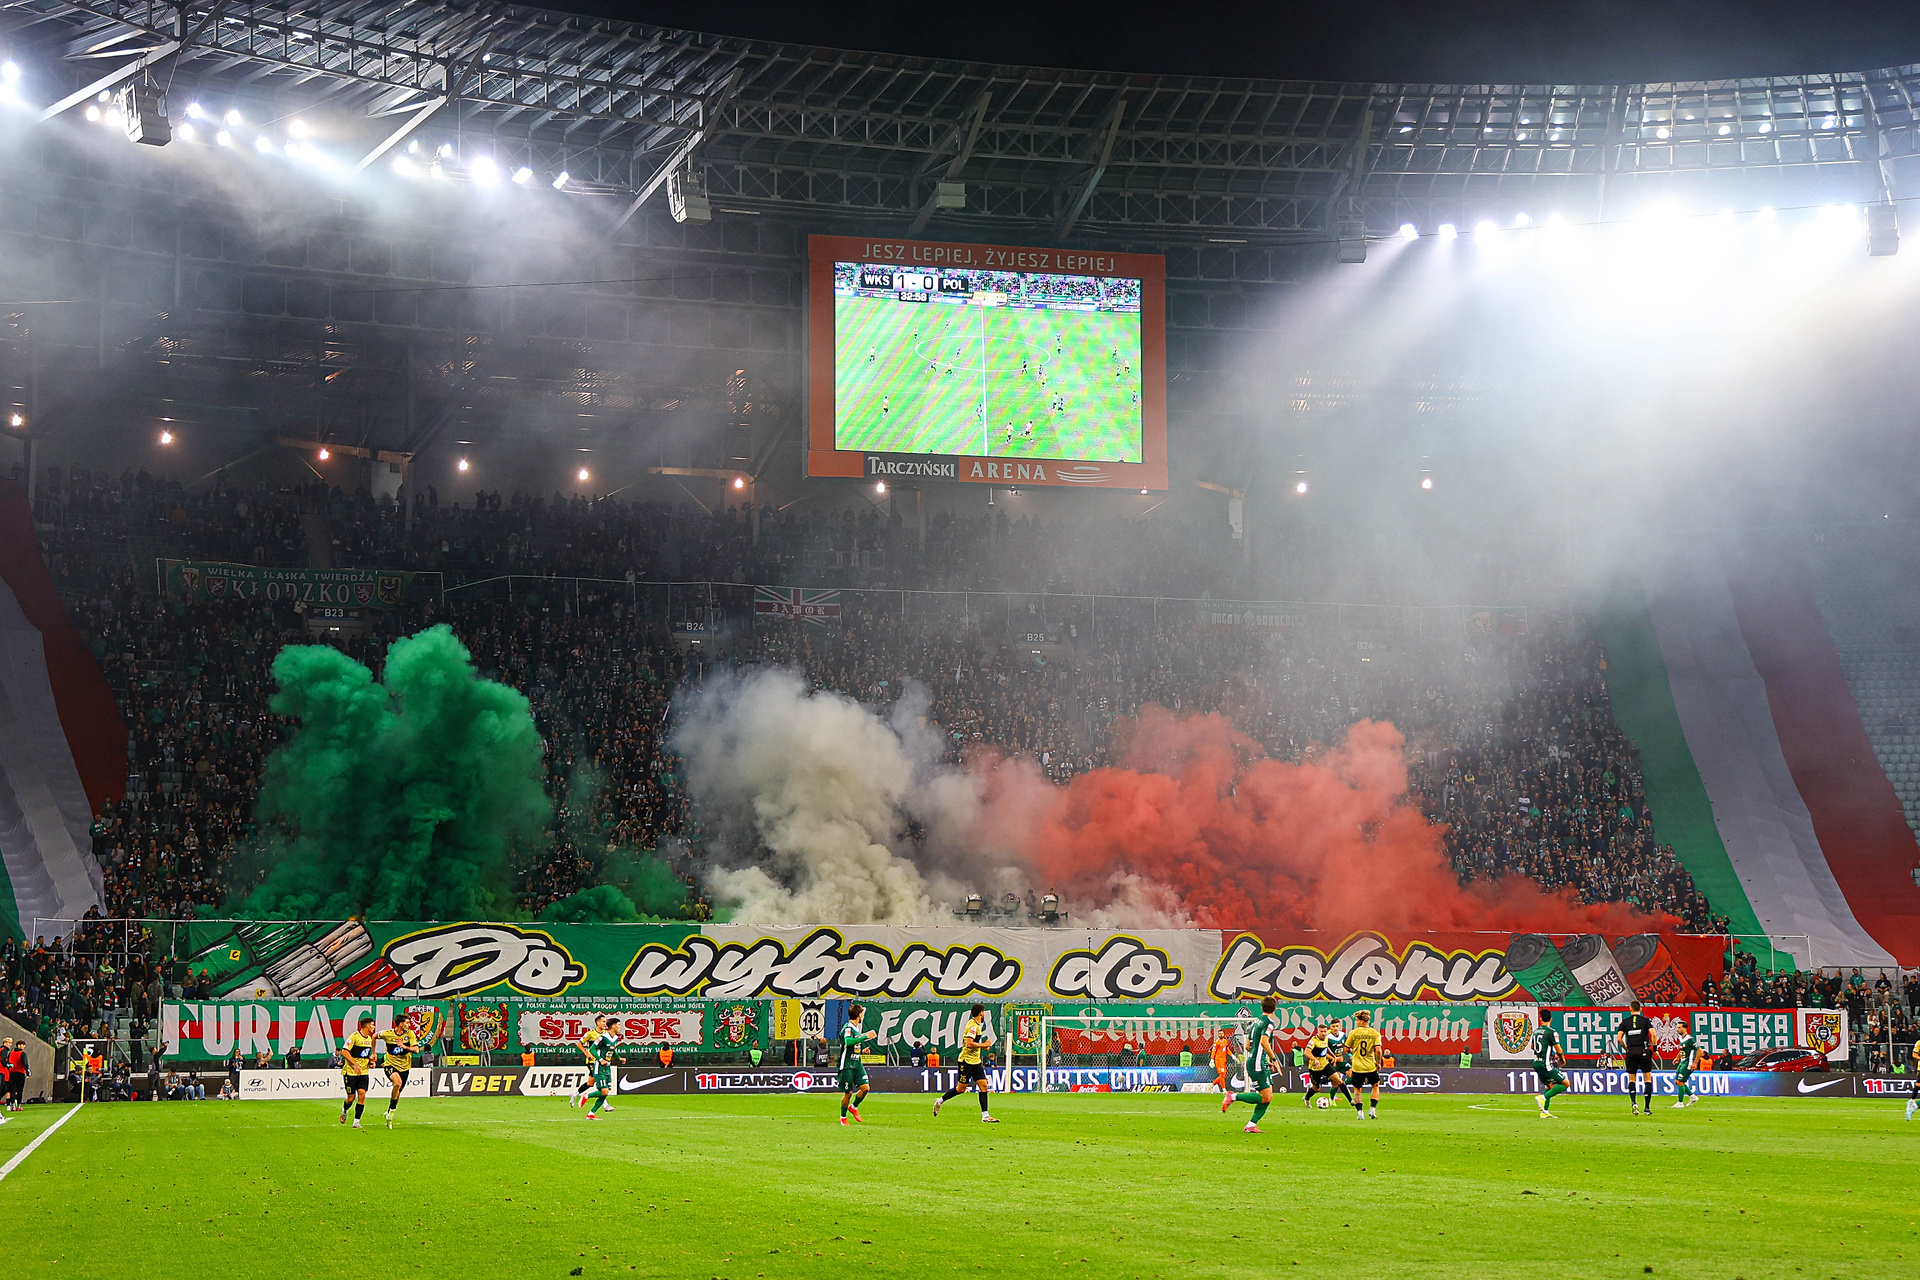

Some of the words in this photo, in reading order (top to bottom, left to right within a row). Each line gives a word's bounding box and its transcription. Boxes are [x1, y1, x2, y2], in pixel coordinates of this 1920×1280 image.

[862, 243, 905, 260] JESZ
[913, 246, 978, 266] LEPIEJ,
[985, 247, 1049, 268] ŻYJESZ
[1057, 254, 1115, 272] LEPIEJ
[864, 273, 891, 287] WKS
[896, 274, 905, 289] 1
[923, 275, 936, 290] 0
[942, 278, 965, 291] POL
[900, 292, 928, 302] 32:58
[867, 456, 955, 477] TARCZYŃSKI
[970, 461, 1047, 480] ARENA
[208, 567, 255, 578] WIELKA
[324, 608, 344, 618] B23
[686, 622, 705, 631] B24
[1027, 633, 1044, 642] B25
[1357, 641, 1374, 650] B26
[625, 931, 1019, 997] wyboru
[1051, 940, 1180, 997] do
[1214, 933, 1516, 999] koloru
[1531, 970, 1564, 993] ULTRAS
[1584, 970, 1617, 994] SMOKE
[1590, 982, 1623, 1004] BOMB
[163, 1003, 393, 1056] FURIACI
[539, 1015, 682, 1040] ŚLSK
[1272, 1004, 1471, 1043] Wroławia
[1694, 1013, 1788, 1034] POLSKA
[1359, 1041, 1368, 1057] 8
[1533, 1035, 1543, 1053] 15
[276, 1074, 331, 1091] Nawrot
[372, 1074, 425, 1091] Narot
[436, 1072, 518, 1093] LVBET
[530, 1073, 586, 1089] LVBET
